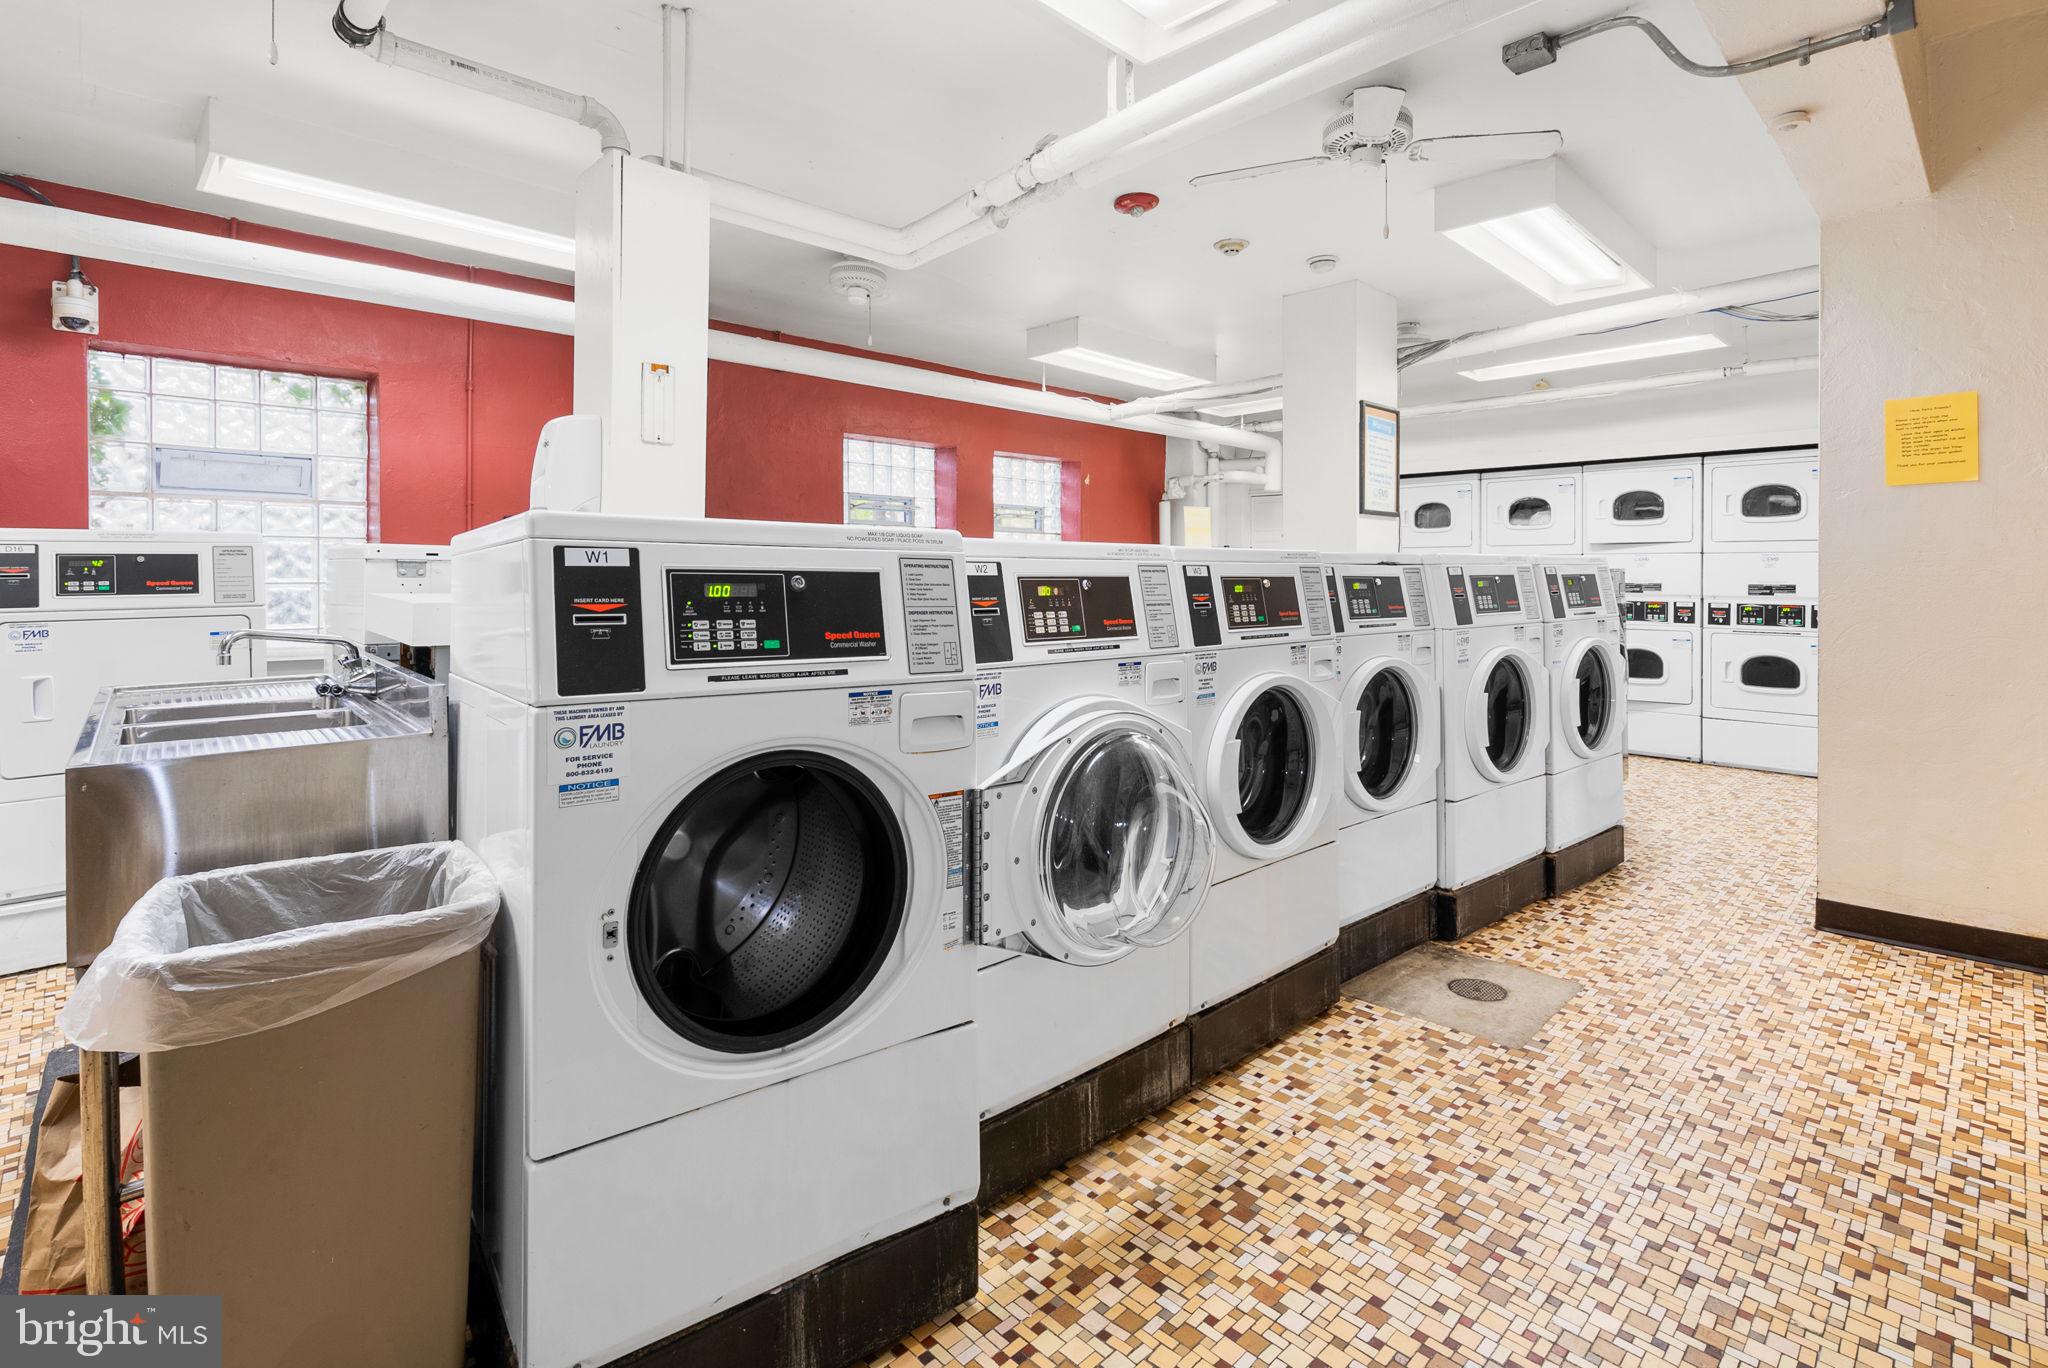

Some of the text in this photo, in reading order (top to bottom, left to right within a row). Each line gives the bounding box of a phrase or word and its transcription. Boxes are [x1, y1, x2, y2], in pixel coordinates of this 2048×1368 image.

[585, 550, 609, 564] W1
[974, 564, 988, 574] W2
[1193, 567, 1202, 575] W3
[22, 629, 49, 640] FMB
[825, 630, 881, 641] Speed Queen
[830, 641, 863, 649] Commercial
[1202, 661, 1217, 675] FMB
[979, 683, 1002, 700] FMB
[579, 722, 625, 749] FMB
[589, 740, 624, 749] LAUNDRY
[582, 753, 614, 761] SERVICE
[576, 761, 603, 769] PHONE
[565, 767, 613, 778] 800-832-6193
[567, 780, 611, 791] NOTICE
